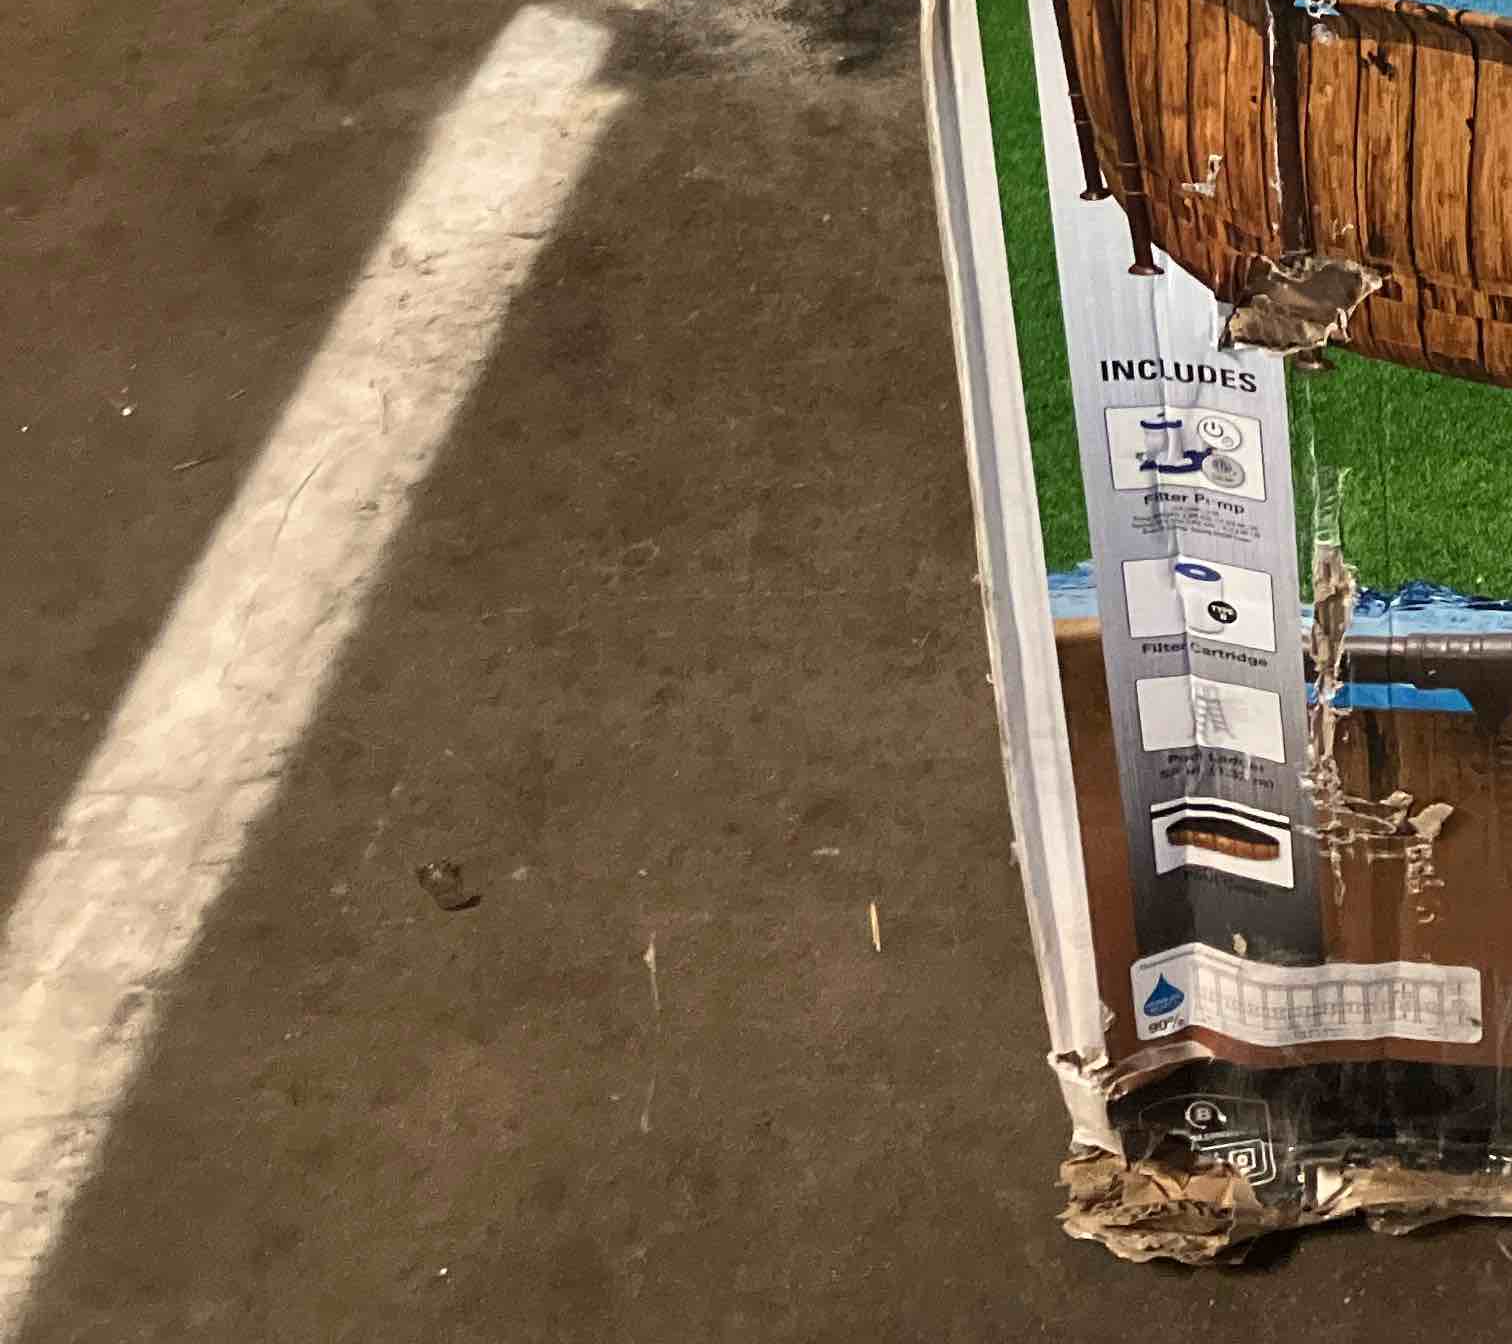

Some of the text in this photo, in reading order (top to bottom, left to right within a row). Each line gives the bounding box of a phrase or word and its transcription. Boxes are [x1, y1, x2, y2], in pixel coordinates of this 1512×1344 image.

[1100, 357, 1258, 394] INCLUDES
[1141, 641, 1269, 668] Filter Cartridge
